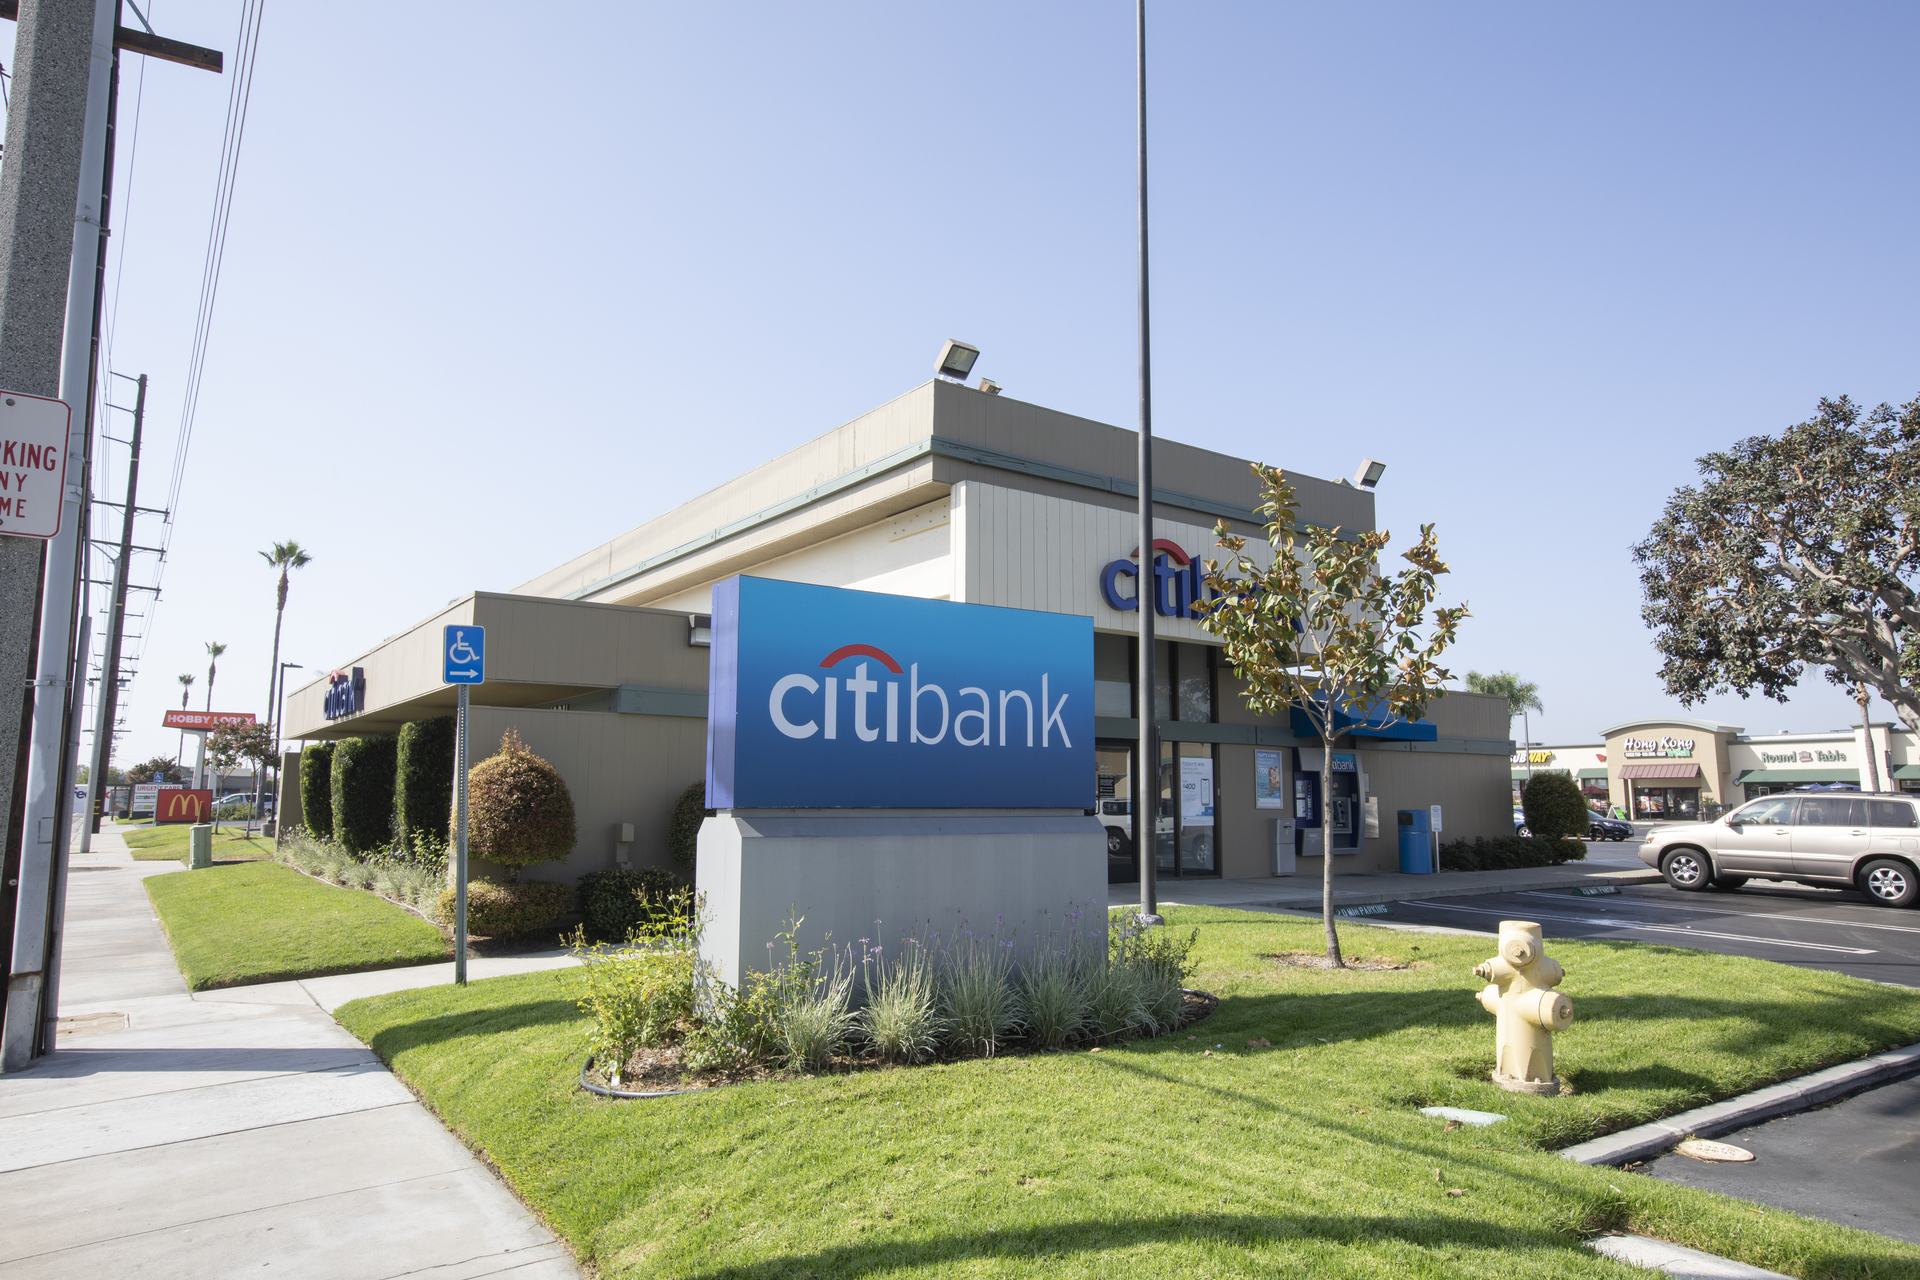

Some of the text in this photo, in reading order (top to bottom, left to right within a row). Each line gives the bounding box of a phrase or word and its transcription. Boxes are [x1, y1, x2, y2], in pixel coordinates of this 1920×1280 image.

[0, 440, 57, 471] KING
[769, 661, 1072, 748] citibank
[167, 714, 211, 724] HOBBY
[1624, 736, 1694, 751] Hong Kong
[1667, 748, 1691, 757] fresh
[1761, 750, 1847, 763] Round Table
[1359, 904, 1388, 916] PARKING
